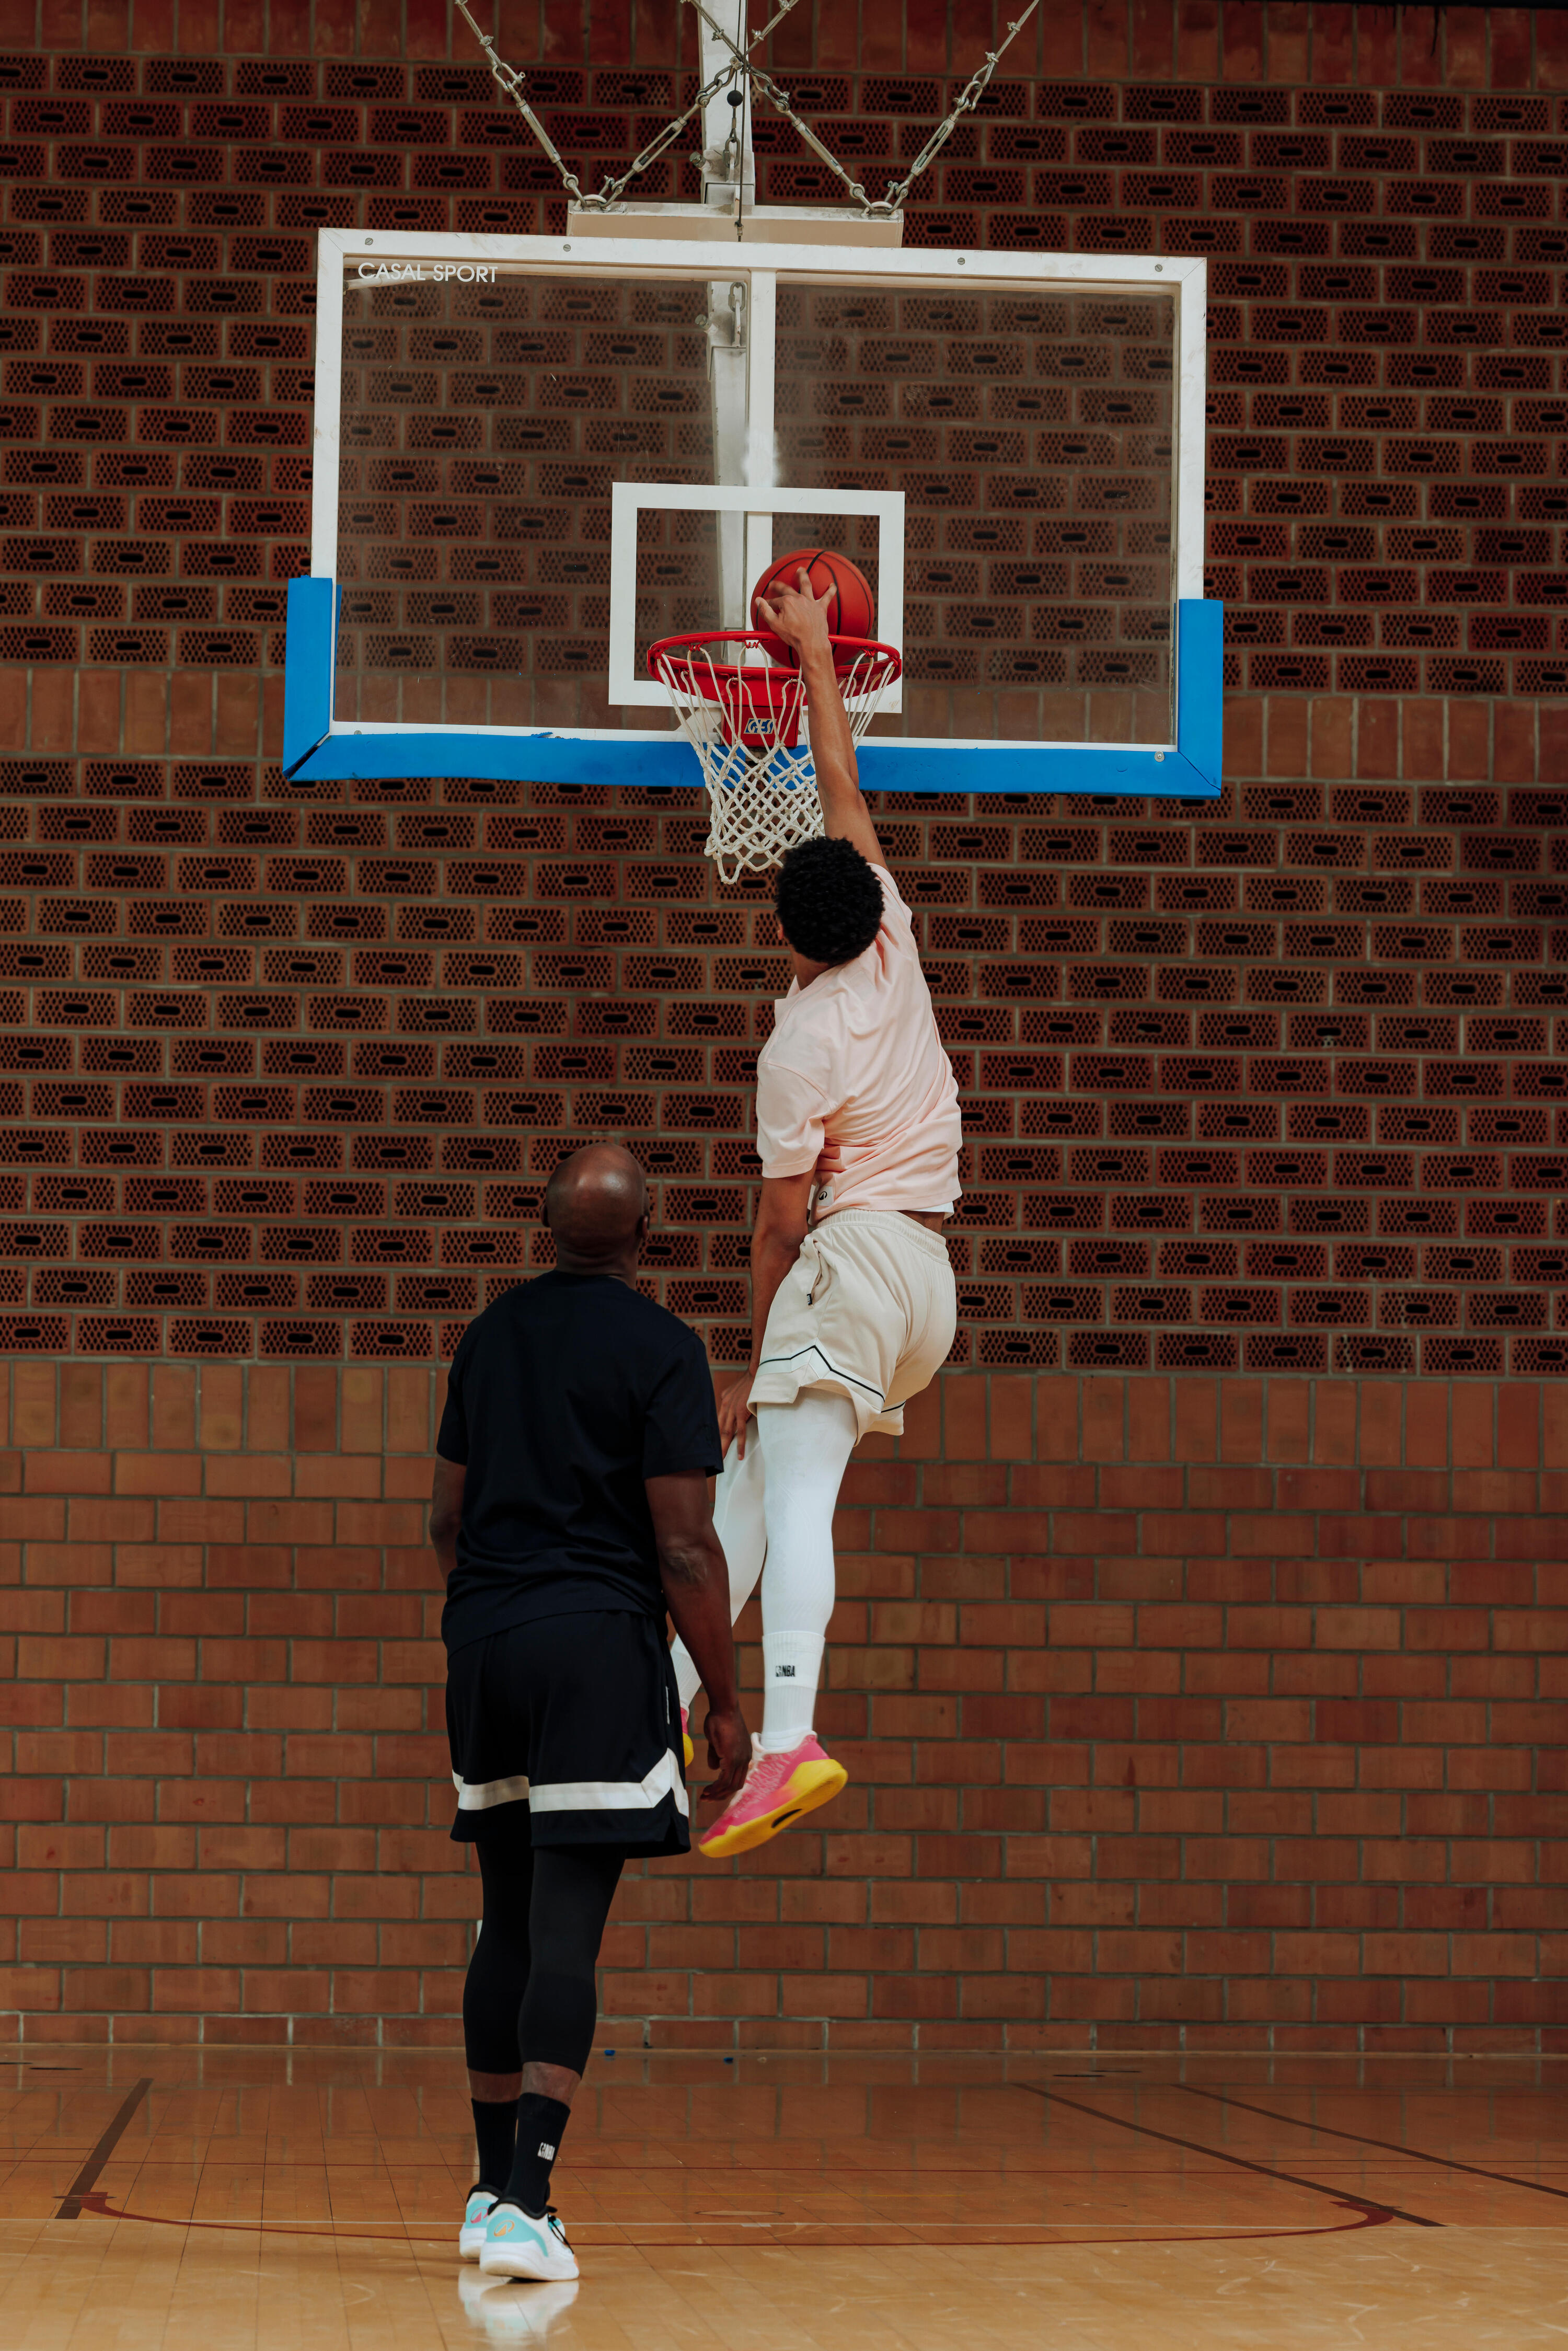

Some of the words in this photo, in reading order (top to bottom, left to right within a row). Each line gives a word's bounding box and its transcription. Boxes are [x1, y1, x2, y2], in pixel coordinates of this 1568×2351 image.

[358, 262, 425, 280] CASAL
[433, 264, 498, 282] SPORT
[782, 1665, 795, 1677] NBA
